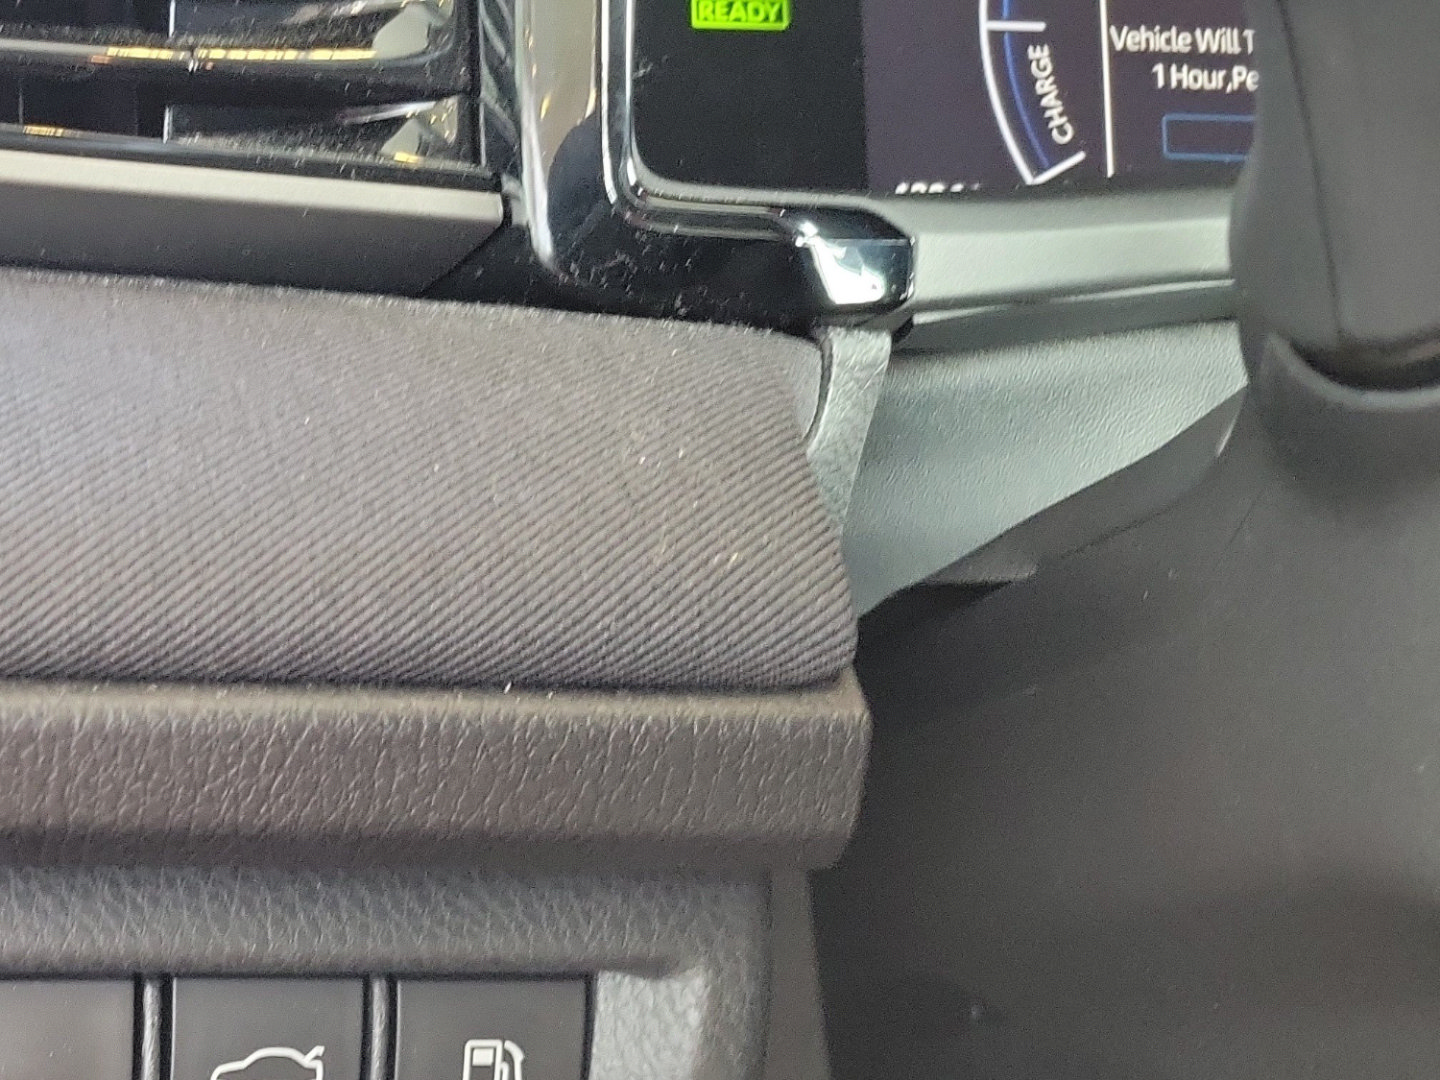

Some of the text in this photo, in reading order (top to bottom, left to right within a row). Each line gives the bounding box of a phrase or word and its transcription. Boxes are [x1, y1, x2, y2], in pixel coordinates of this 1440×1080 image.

[698, 0, 780, 22] READY
[1110, 24, 1192, 53] Vehicle
[1194, 26, 1241, 54] Will
[1151, 62, 1165, 89] 1
[1027, 44, 1074, 145] CHARGE
